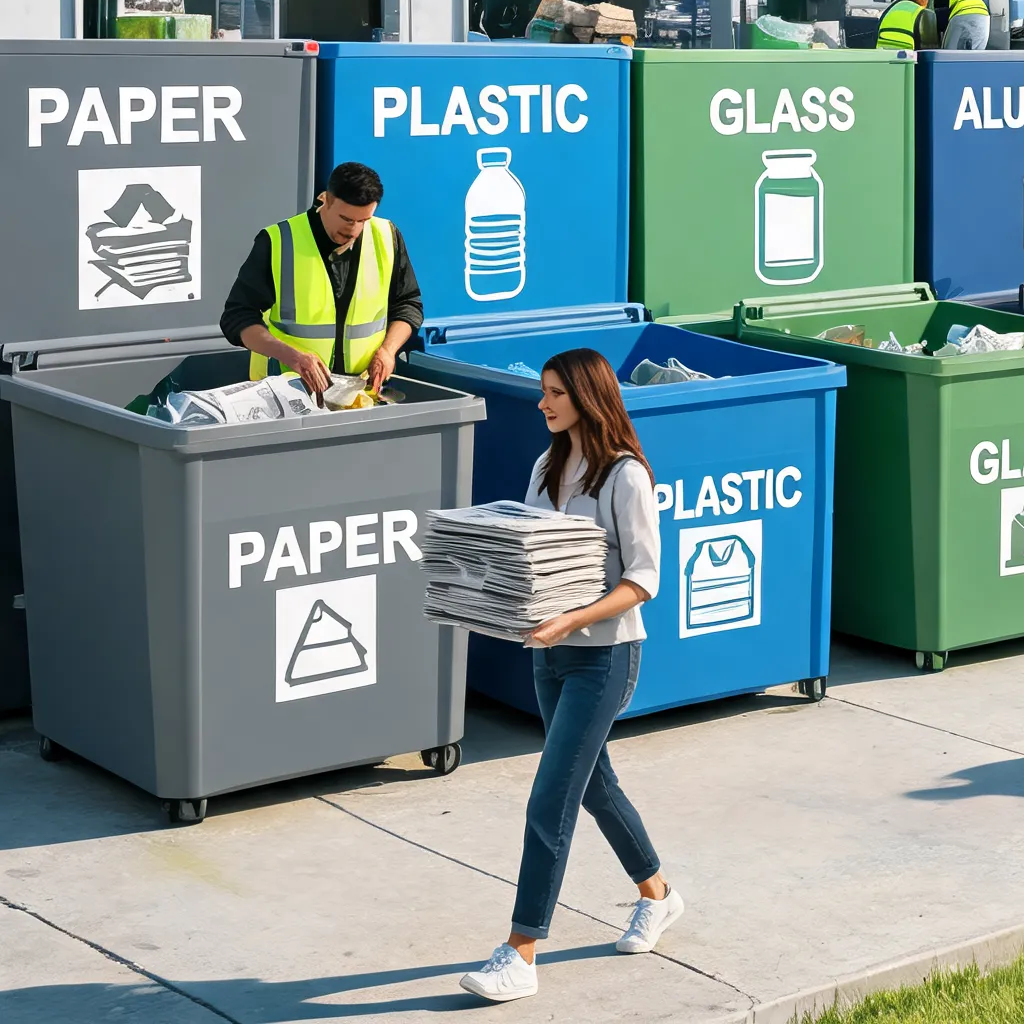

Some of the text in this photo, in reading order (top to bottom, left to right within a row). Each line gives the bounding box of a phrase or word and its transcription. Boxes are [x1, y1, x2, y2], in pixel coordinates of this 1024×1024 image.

[27, 85, 247, 148] PAPER
[373, 83, 589, 138] PLASTIC
[709, 86, 856, 136] GLASS
[654, 466, 802, 520] PLASTIC
[228, 509, 424, 589] PAPER
